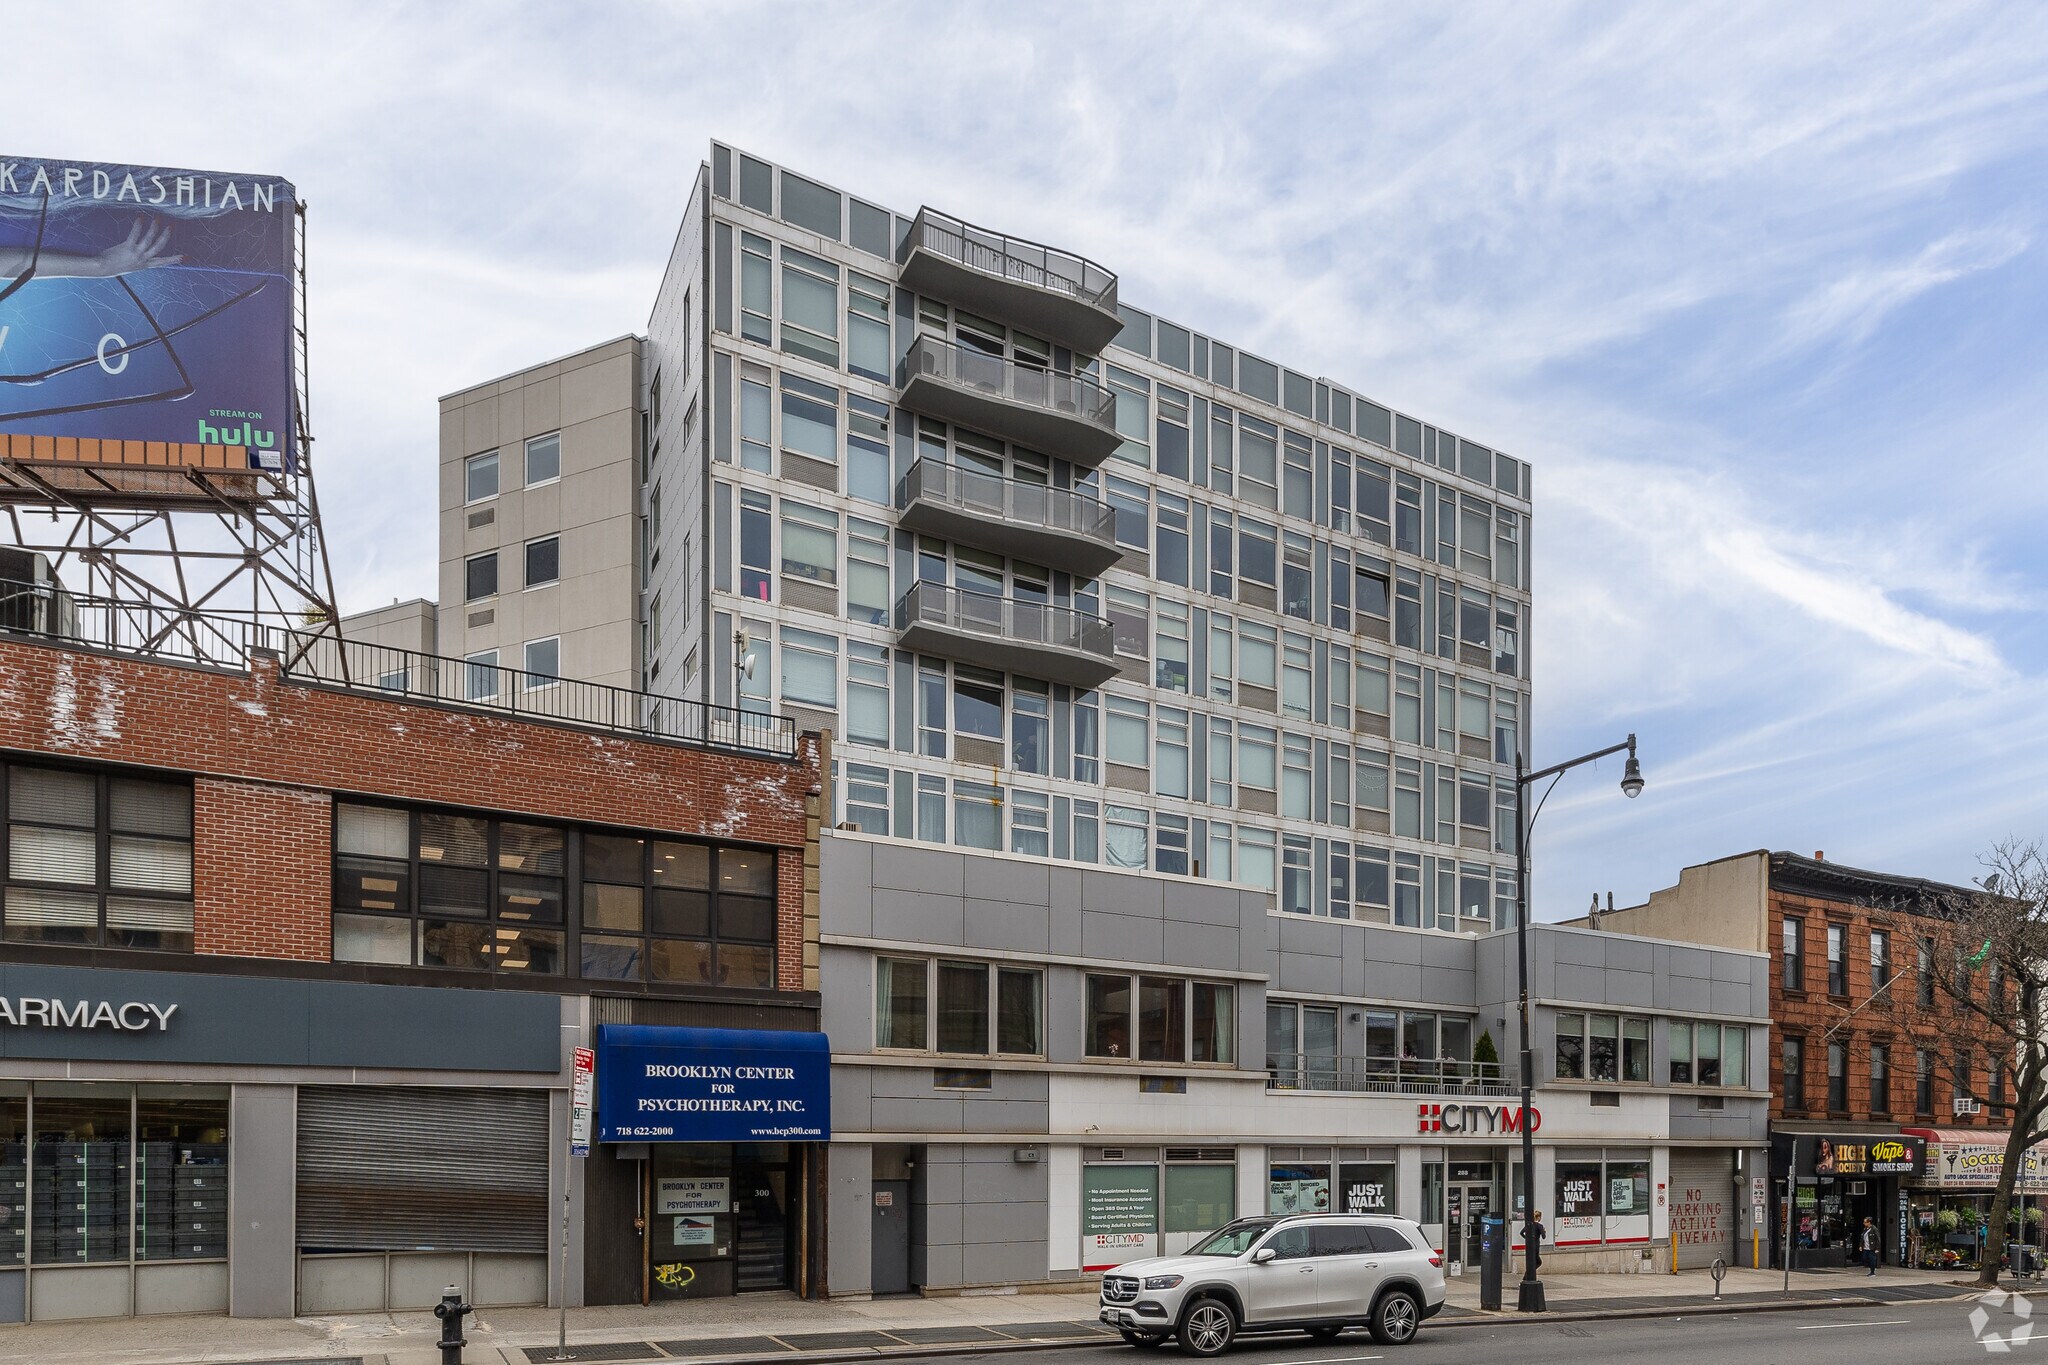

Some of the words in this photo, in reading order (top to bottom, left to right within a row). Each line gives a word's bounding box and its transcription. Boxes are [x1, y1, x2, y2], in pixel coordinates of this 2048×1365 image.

[0, 163, 274, 213] KARDASHIAN
[209, 409, 246, 418] STREAM
[199, 420, 274, 447] hulu
[645, 1064, 731, 1079] BROOKLYN
[735, 1066, 795, 1079] CENTER
[711, 1083, 735, 1094] FOR
[637, 1098, 773, 1114] PSYCHOTHERAPY,
[776, 1100, 805, 1112] INC.
[1441, 1104, 1541, 1132] CITYMD
[616, 1127, 632, 1136] 718
[634, 1127, 673, 1136] 622-2000
[751, 1126, 821, 1137] www.bcp300.com
[1834, 1145, 1866, 1160] HIGH
[1872, 1142, 1904, 1162] Vape
[1905, 1150, 1911, 1160] &
[1835, 1163, 1866, 1172] SOCIETY
[1872, 1163, 1895, 1172] SMOKE
[1897, 1163, 1913, 1171] SHOP
[1349, 1184, 1383, 1196] JUST
[1564, 1181, 1592, 1191] JUST
[755, 1189, 770, 1197] 300
[1564, 1191, 1593, 1201] WALK
[1687, 1189, 1702, 1201] NO
[667, 1201, 720, 1209] PSYCHOTHERAPY
[1349, 1196, 1385, 1207] WALK
[1564, 1202, 1575, 1212] IN
[1668, 1203, 1721, 1216] PARKING
[1569, 1217, 1594, 1225] CITYMD
[1671, 1217, 1716, 1230] ACTIVE
[1106, 1234, 1144, 1244] CITYMD
